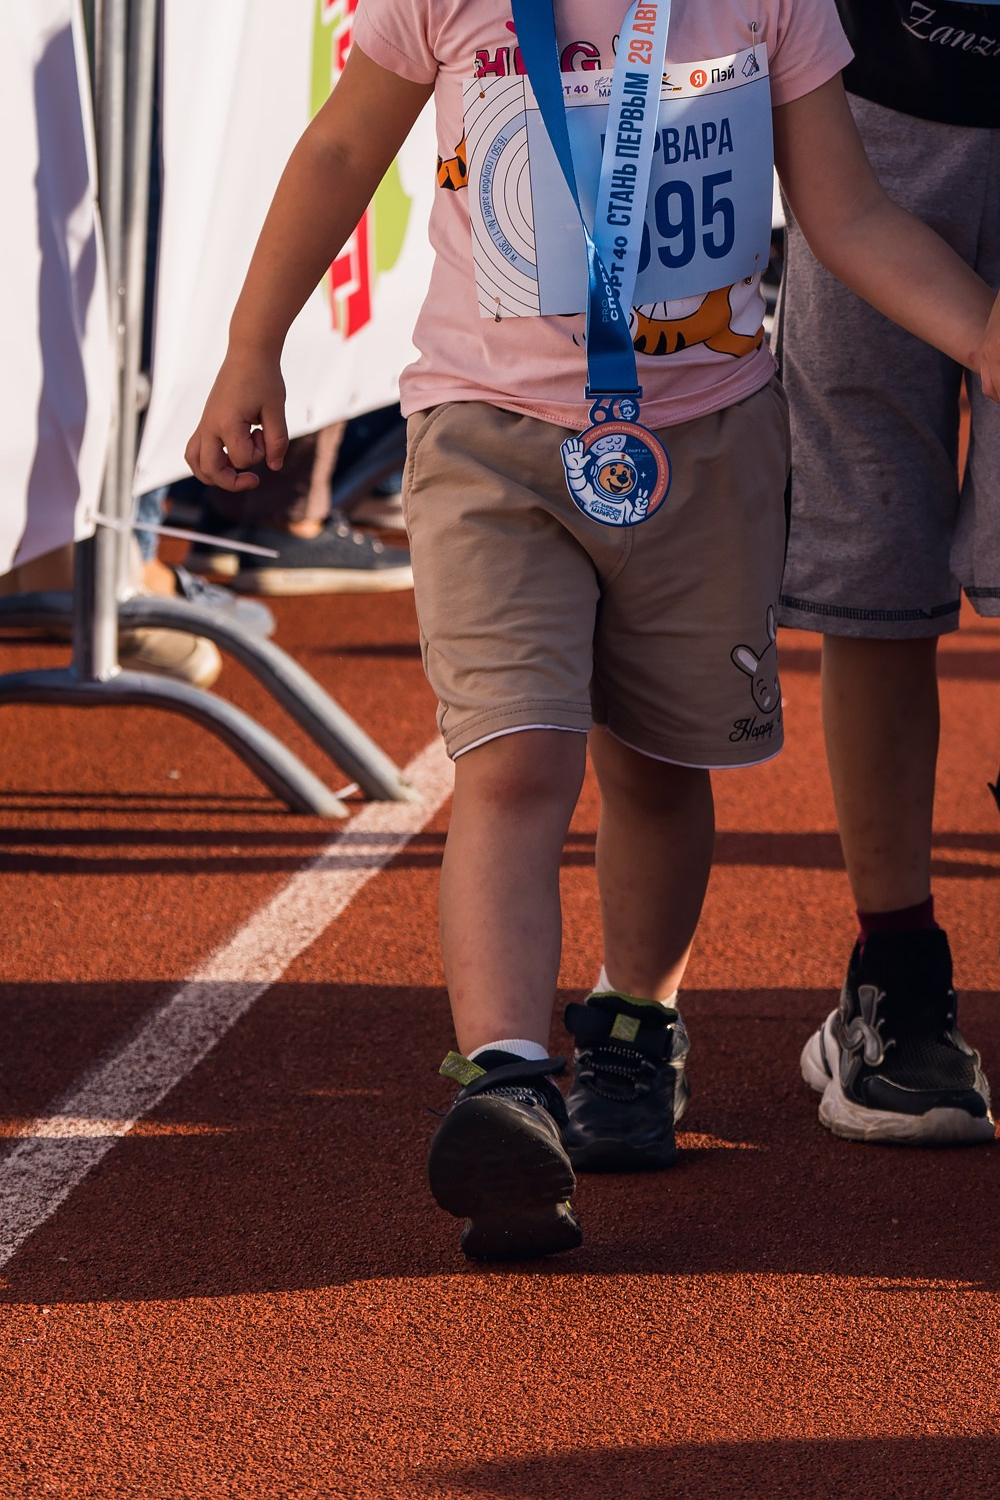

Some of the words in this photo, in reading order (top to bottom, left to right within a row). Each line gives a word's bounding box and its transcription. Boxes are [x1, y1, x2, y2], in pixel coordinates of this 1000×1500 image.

[627, 39, 653, 65] 29
[711, 64, 735, 84] Пэй
[573, 85, 588, 94] 40
[615, 72, 649, 159] ПЕРВЫМ
[490, 135, 507, 156] 16:50
[481, 160, 494, 194] голубой
[607, 163, 638, 226] СТАНЬ
[482, 196, 493, 219] забег
[498, 240, 513, 256] 300
[510, 254, 518, 263] м
[612, 236, 628, 260] 40
[729, 716, 775, 742] Happy
